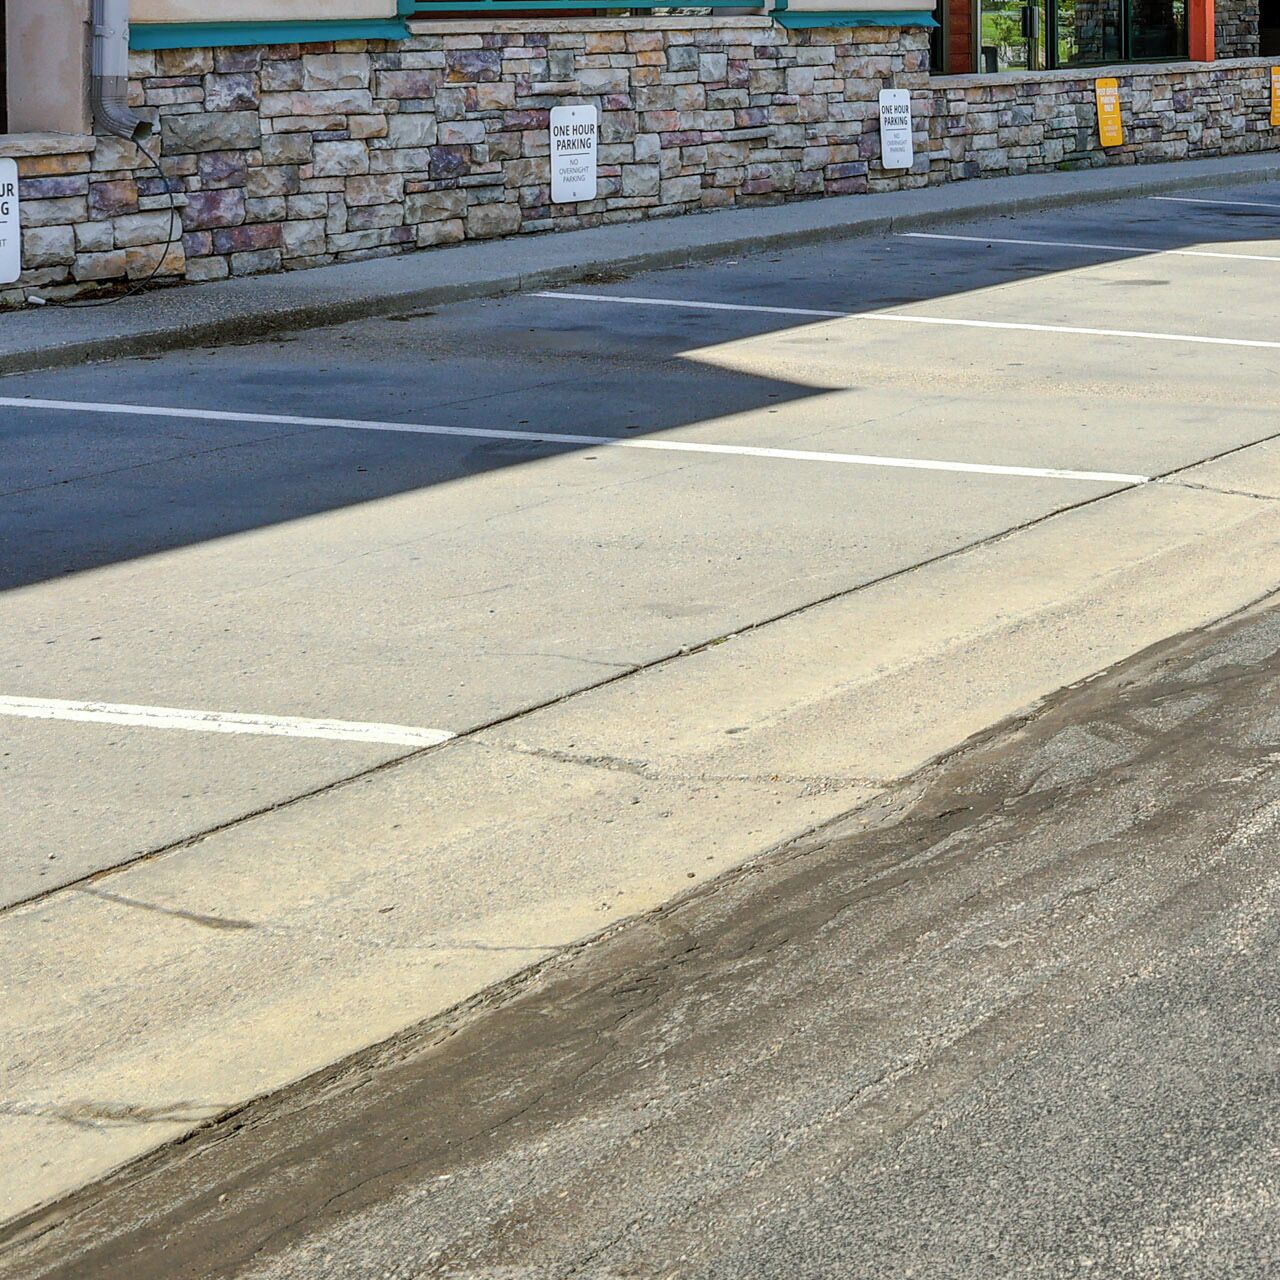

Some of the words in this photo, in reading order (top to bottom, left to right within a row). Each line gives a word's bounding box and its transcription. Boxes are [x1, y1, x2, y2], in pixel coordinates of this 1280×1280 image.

[882, 105, 893, 114] ONE
[894, 104, 909, 114] HOUR
[884, 116, 908, 126] PARKING
[553, 125, 570, 137] ONE
[572, 123, 595, 135] HOUR
[556, 137, 592, 151] PARKING
[569, 158, 579, 166] NO
[559, 166, 589, 175] OVERNIGHT
[563, 175, 586, 183] PARKING
